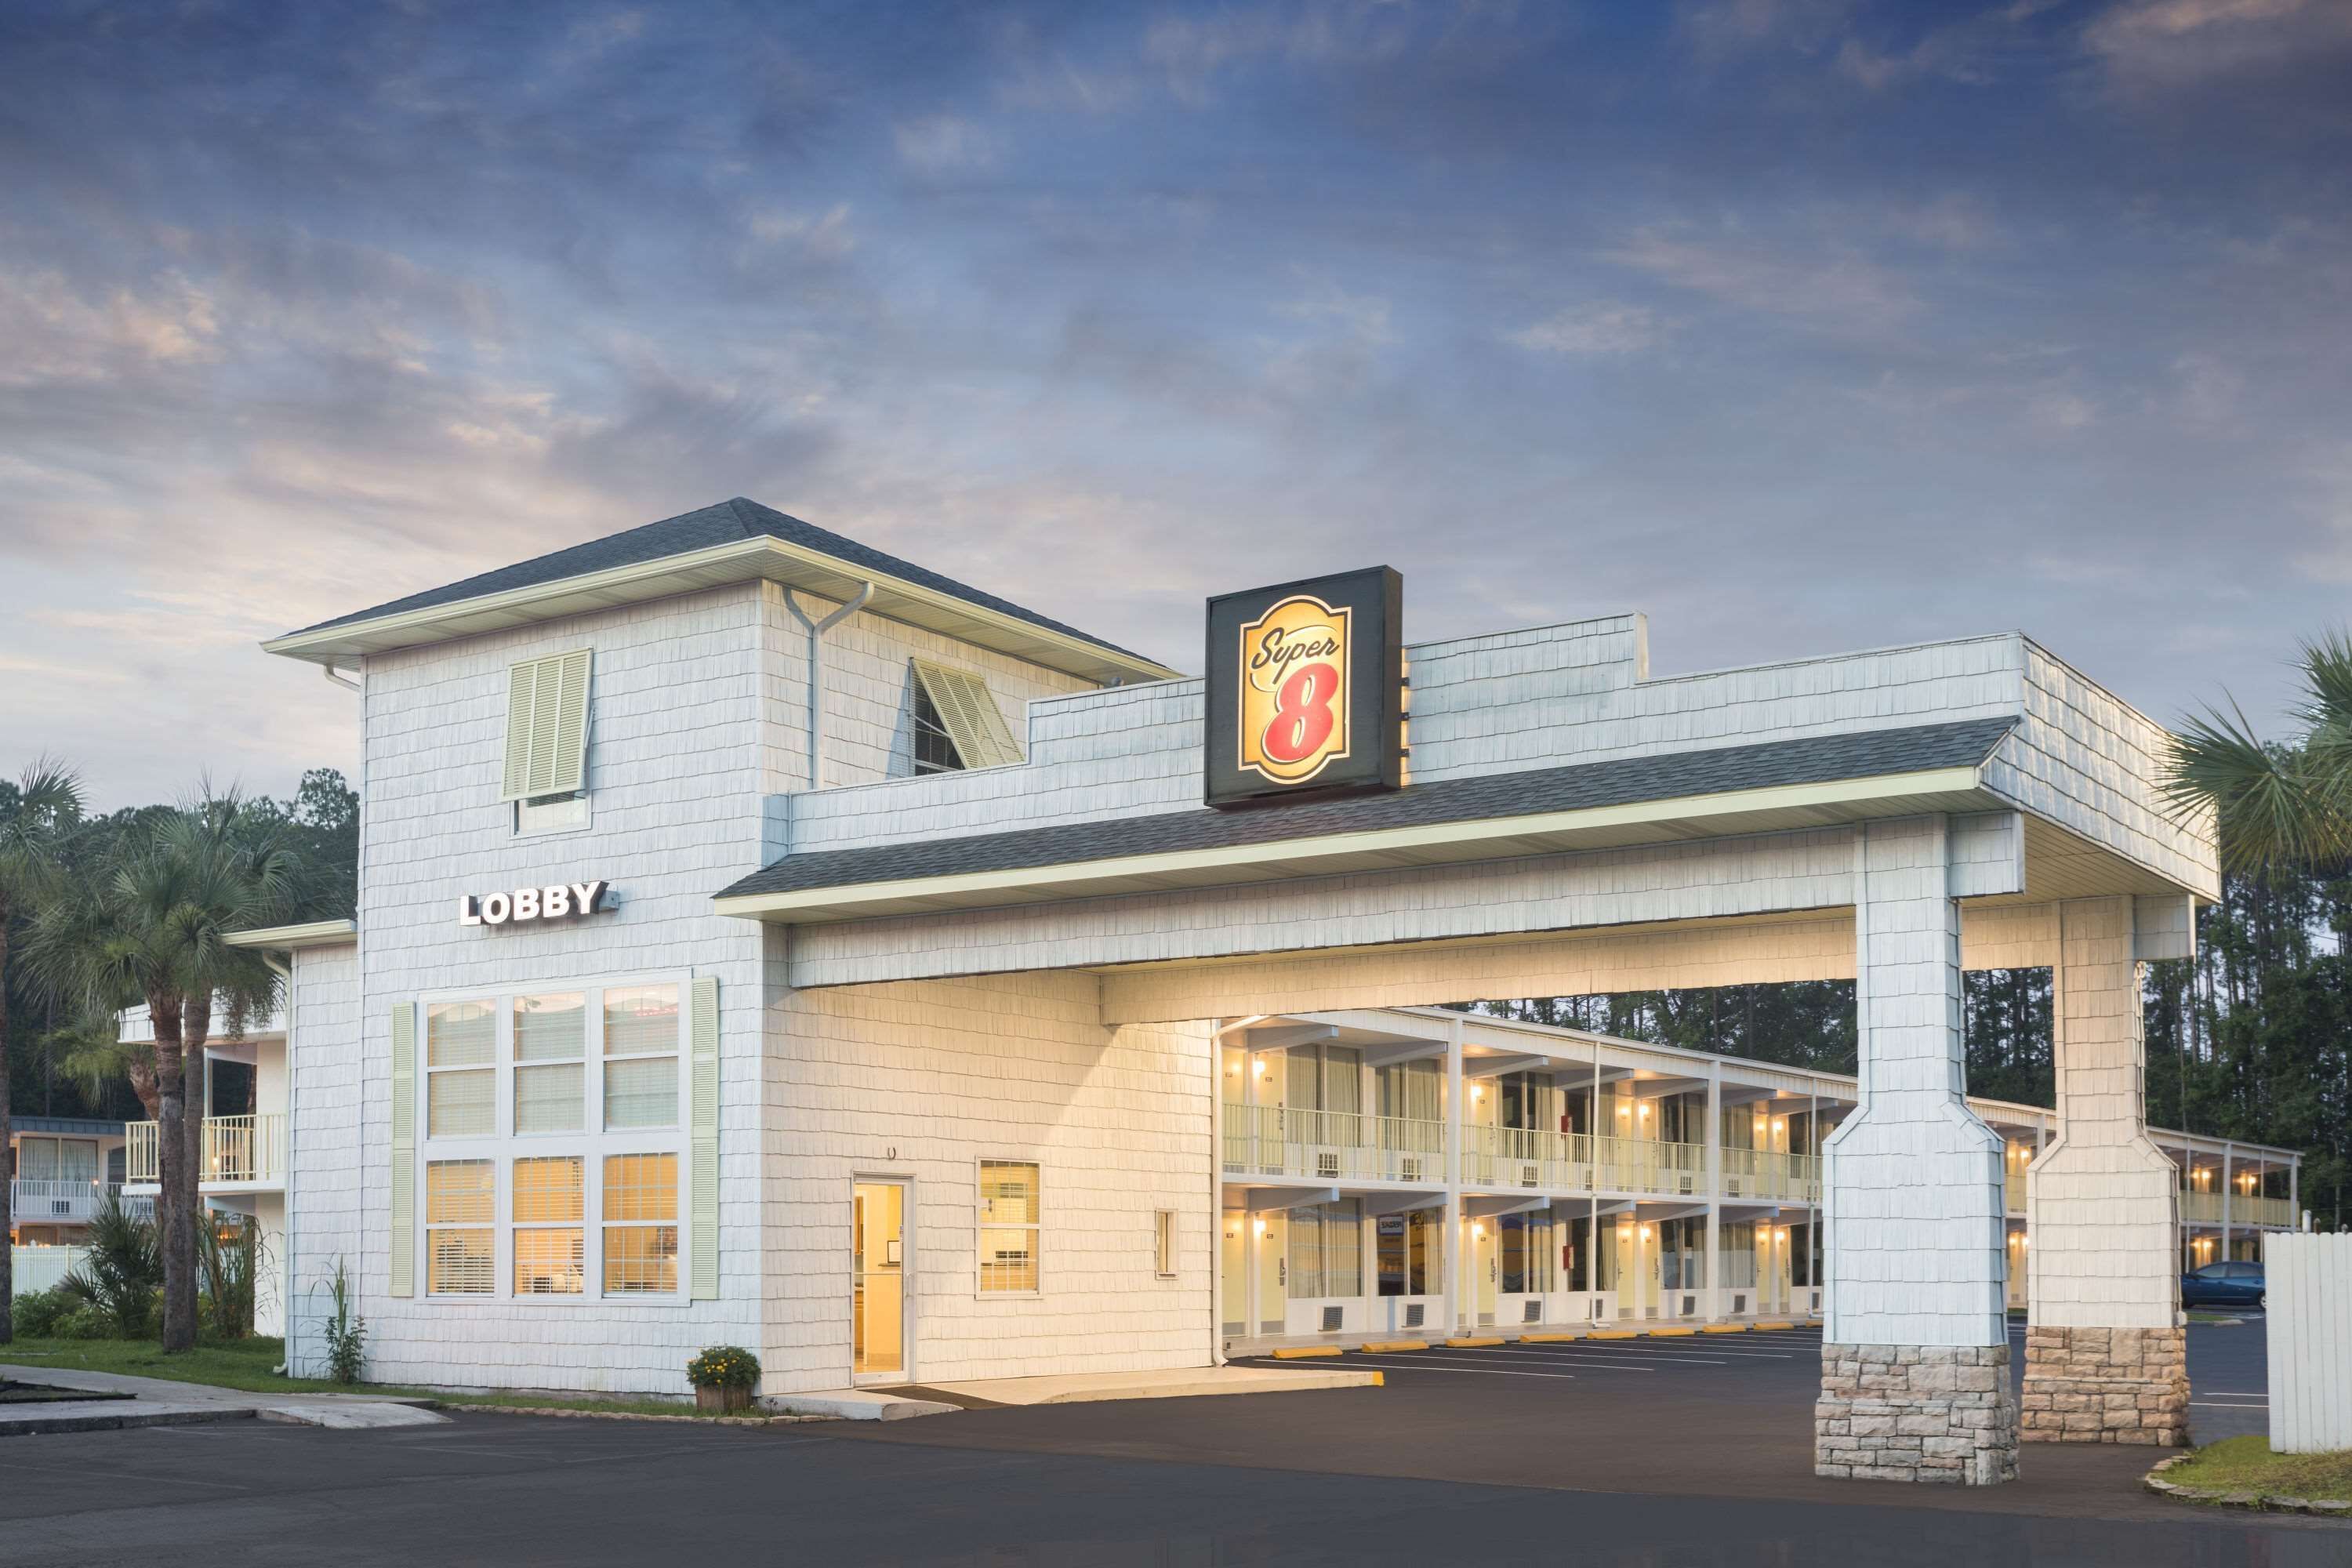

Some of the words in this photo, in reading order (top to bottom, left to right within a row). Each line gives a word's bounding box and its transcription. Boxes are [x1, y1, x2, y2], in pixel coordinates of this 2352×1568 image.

[1251, 627, 1340, 685] Super
[1262, 663, 1338, 763] 8
[459, 880, 604, 925] LOBBY
